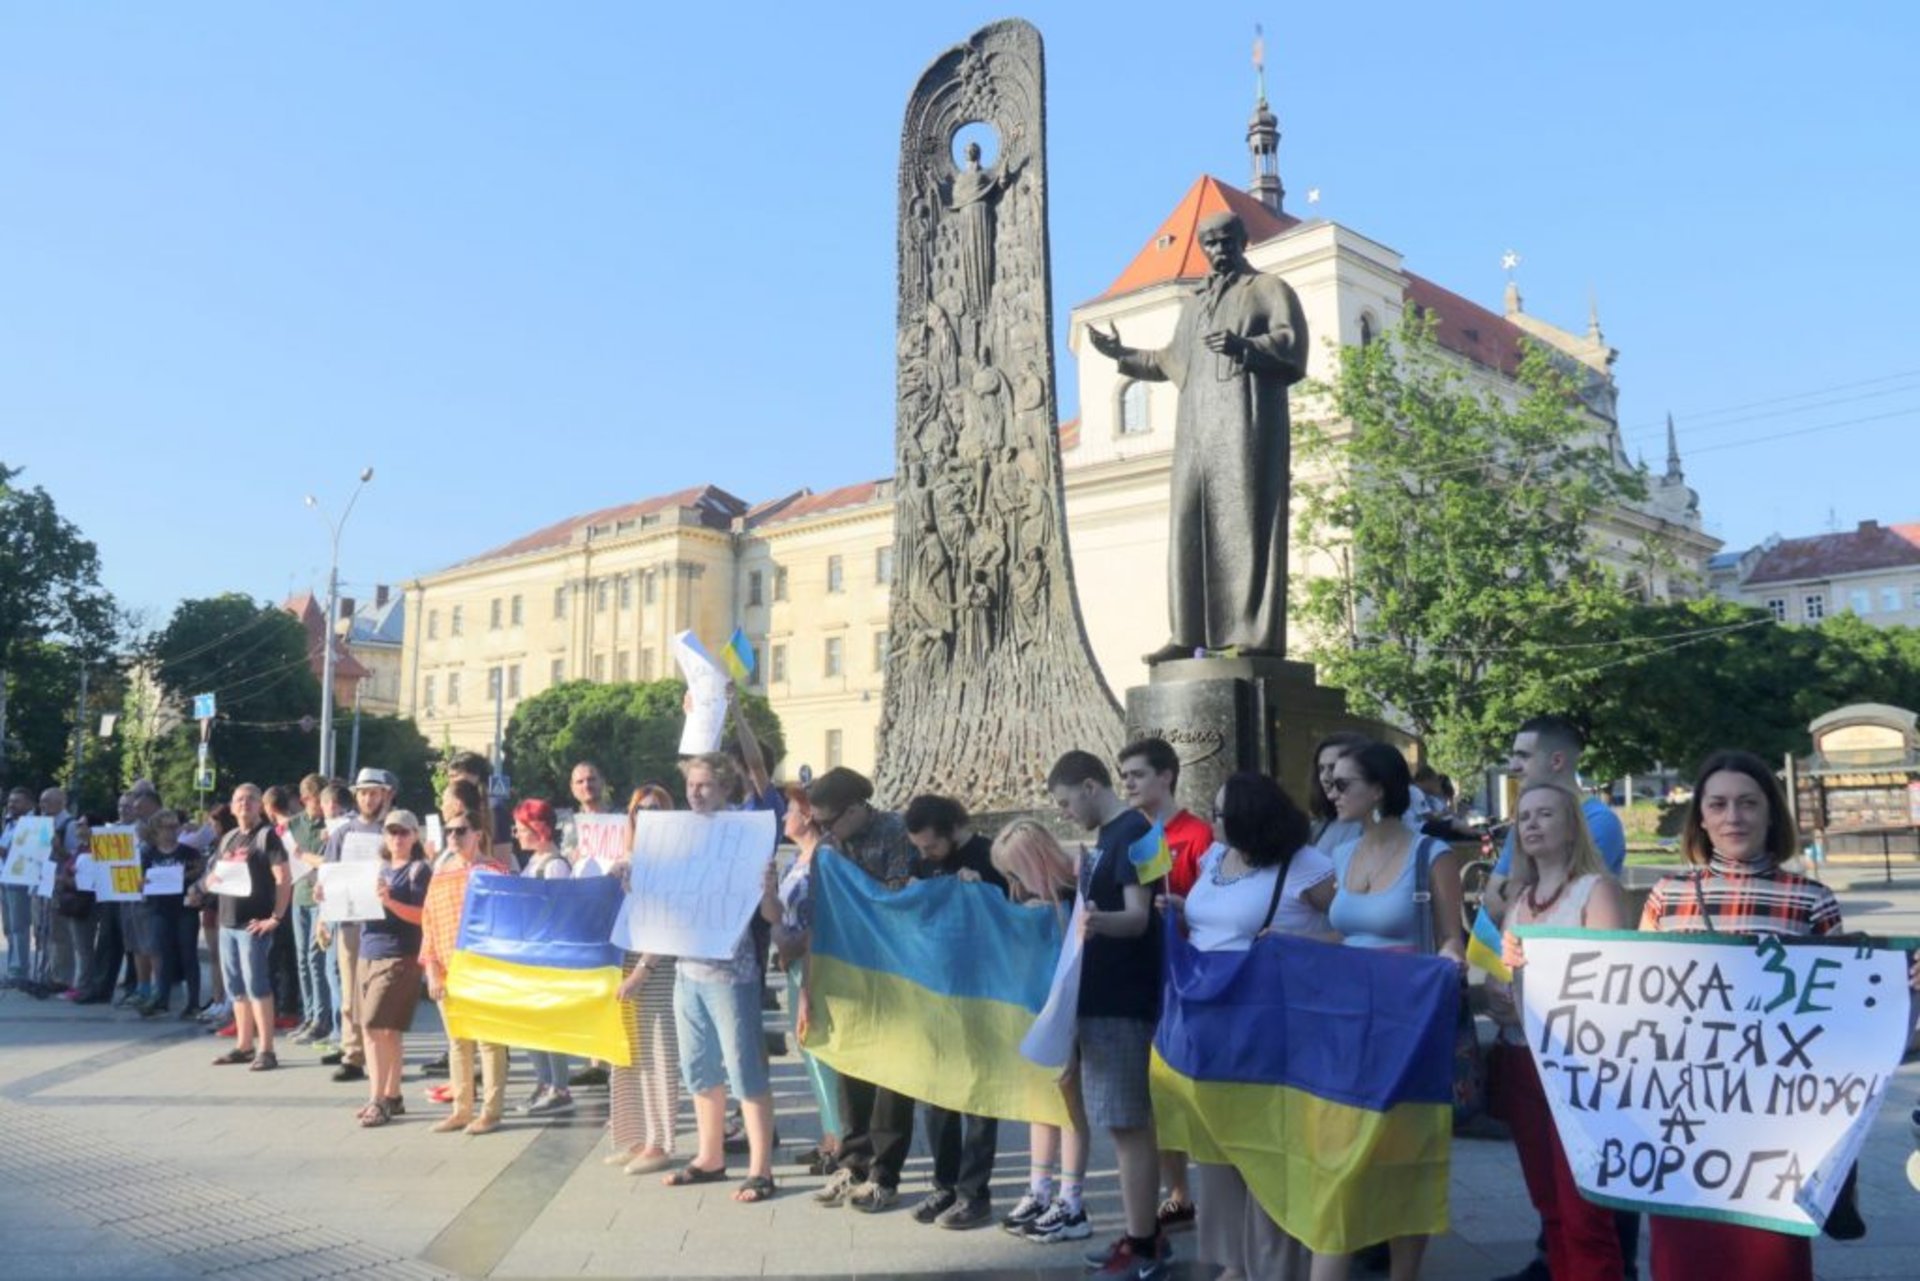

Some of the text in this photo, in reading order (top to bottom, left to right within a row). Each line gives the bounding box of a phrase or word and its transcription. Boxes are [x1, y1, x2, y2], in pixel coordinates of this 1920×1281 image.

[1558, 951, 1734, 1012] ЕПОХА
[1542, 1057, 1753, 1114] ТРІЛЯТИ
[1659, 1104, 1706, 1144] А
[1597, 1138, 1804, 1201] ВОРОГА
